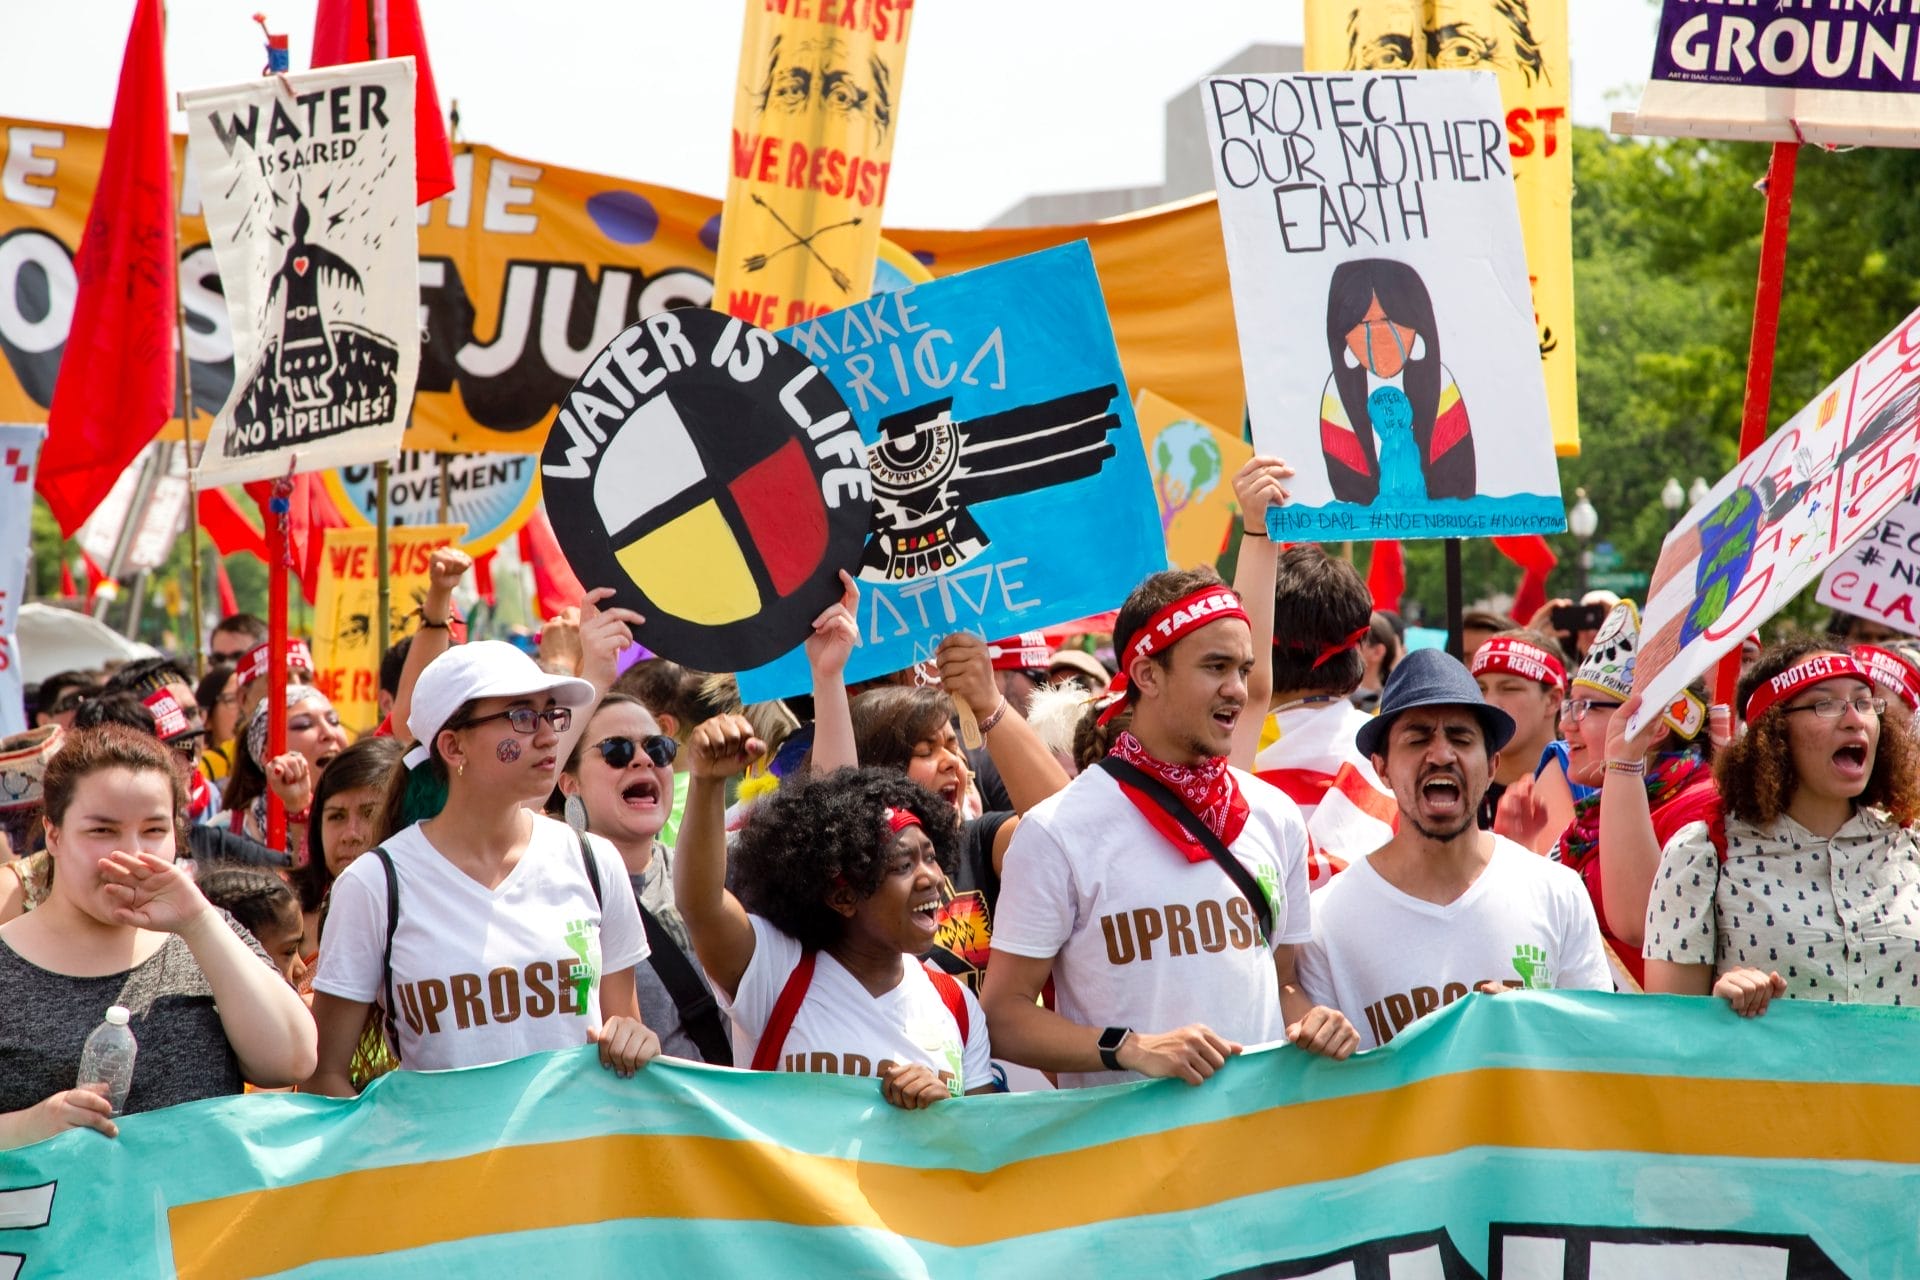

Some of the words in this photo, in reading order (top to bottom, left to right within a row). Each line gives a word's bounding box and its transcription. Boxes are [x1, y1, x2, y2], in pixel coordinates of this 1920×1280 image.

[1668, 71, 1681, 79] ART
[1671, 13, 1920, 82] GROUN
[210, 85, 389, 158] WATER
[1210, 75, 1417, 140] PROTECT
[258, 155, 275, 177] IS
[278, 138, 357, 173] SACRED
[732, 128, 782, 183] WE
[786, 141, 891, 208] RESIST
[1221, 133, 1325, 189] OUR
[1338, 119, 1506, 186] MOTHER
[1273, 180, 1428, 253] EARTH
[790, 286, 931, 360] MAKE
[821, 326, 1006, 412] RICA
[234, 420, 267, 448] NO
[271, 395, 391, 441] PIPELINES!
[542, 312, 697, 479] WATER
[710, 317, 779, 382] IS
[778, 365, 873, 508] LIFE
[1384, 406, 1395, 417] IS
[1271, 511, 1312, 533] #NO
[1319, 511, 1360, 531] DAPL
[1369, 511, 1487, 530] #NOENBRIDGE
[329, 545, 369, 579] WE
[856, 557, 1042, 649] ATIVE
[1134, 633, 1154, 656] IT
[1156, 593, 1238, 637] TAKES
[1507, 654, 1547, 681] RENEW
[1508, 641, 1548, 664] RESIST
[1770, 656, 1833, 694] PROTECT
[1869, 666, 1904, 695] RENEW
[1871, 651, 1908, 681] RESIST
[397, 958, 583, 1037] UPROSE
